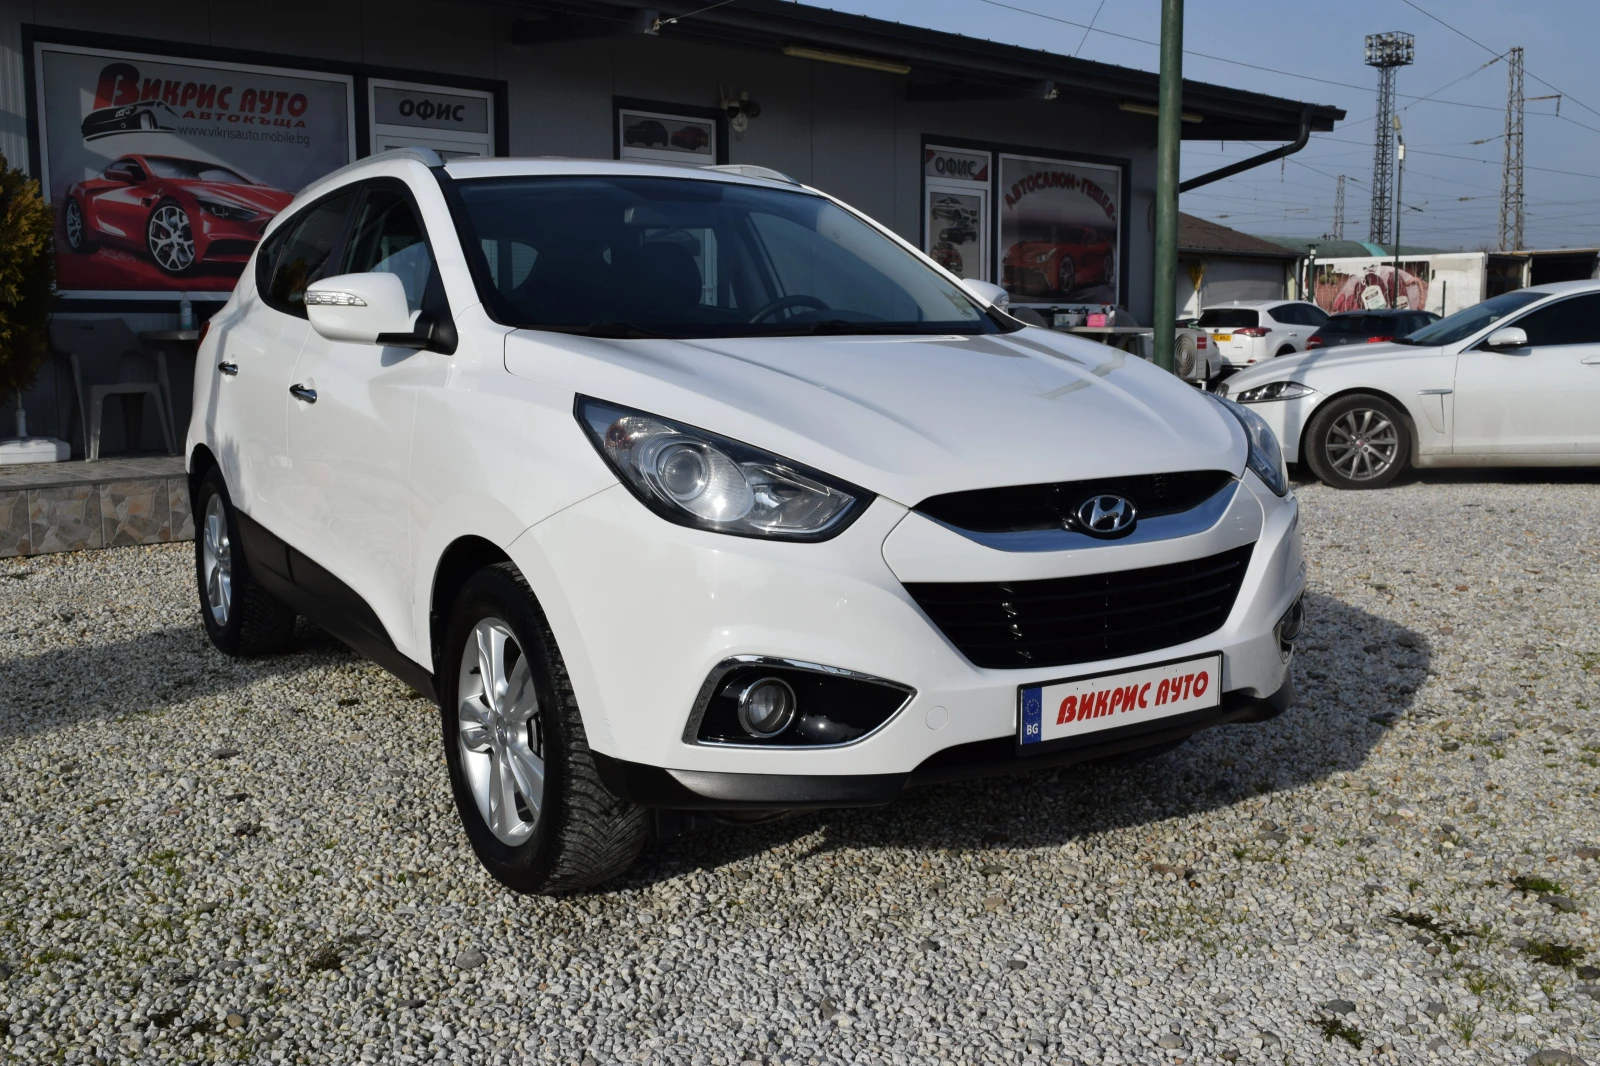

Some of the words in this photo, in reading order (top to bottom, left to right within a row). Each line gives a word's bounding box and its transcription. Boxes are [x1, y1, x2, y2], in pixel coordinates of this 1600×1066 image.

[93, 63, 232, 110] ВИКРИС
[239, 88, 308, 117] АУТО
[182, 110, 307, 129] АВТОКЪЩА
[398, 99, 465, 122] ОФИС
[177, 125, 310, 147] www.vikrisauto.mobile.bg
[935, 156, 977, 176] ОФИС
[1056, 682, 1151, 725] ВИКРИС
[1154, 671, 1209, 706] АУТО
[1026, 723, 1039, 735] BG
